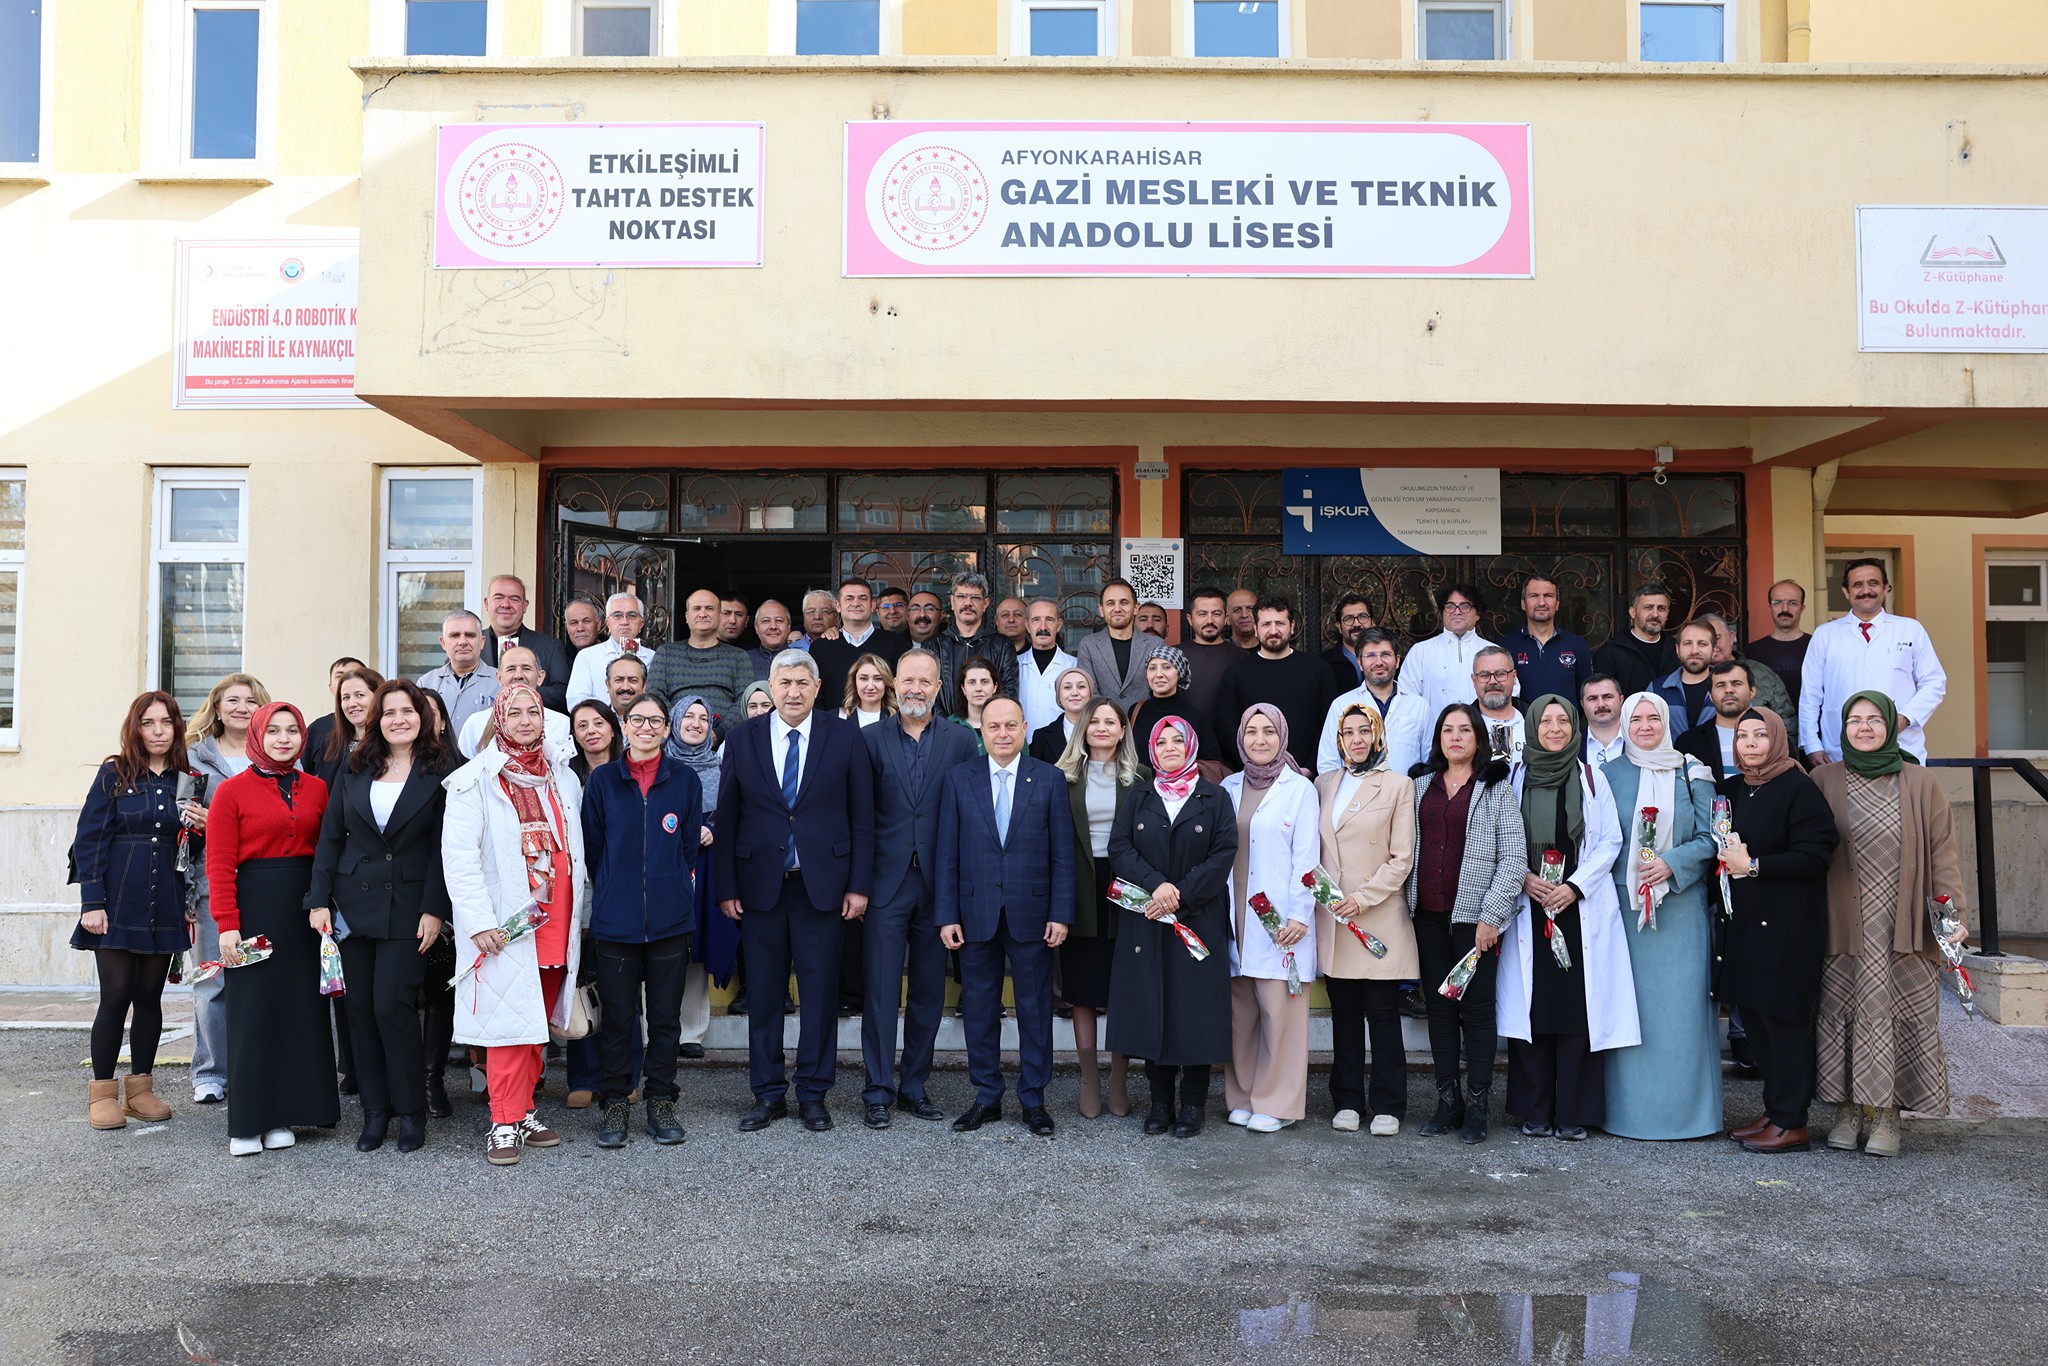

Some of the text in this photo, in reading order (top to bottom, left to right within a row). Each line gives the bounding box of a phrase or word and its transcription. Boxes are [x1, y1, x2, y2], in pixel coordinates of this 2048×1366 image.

[588, 148, 739, 179] ETKİLEŞİMLİ
[1001, 147, 1202, 166] AFYONKARAHİSAR
[572, 188, 754, 208] TAHTA DESTEK
[1000, 173, 1498, 207] GAZİ MESLEKİ VE TEKNİK
[609, 220, 716, 240] NOKTASI
[1000, 216, 1333, 248] ANADOLU LİSESİ
[1923, 271, 2004, 284] Z-Kütüphane
[213, 304, 269, 326] ENDÜSTRİ
[273, 308, 292, 326] 4.0
[296, 304, 346, 326] ROBOTİK
[1870, 300, 1889, 314] Bu
[1894, 299, 1950, 314] Okulda
[1906, 323, 2025, 338] Bulunmaktadır.
[193, 336, 264, 358] MAKİNELERİ
[268, 336, 285, 358] İLE
[215, 378, 230, 387] proje
[290, 378, 309, 386] Ajansı
